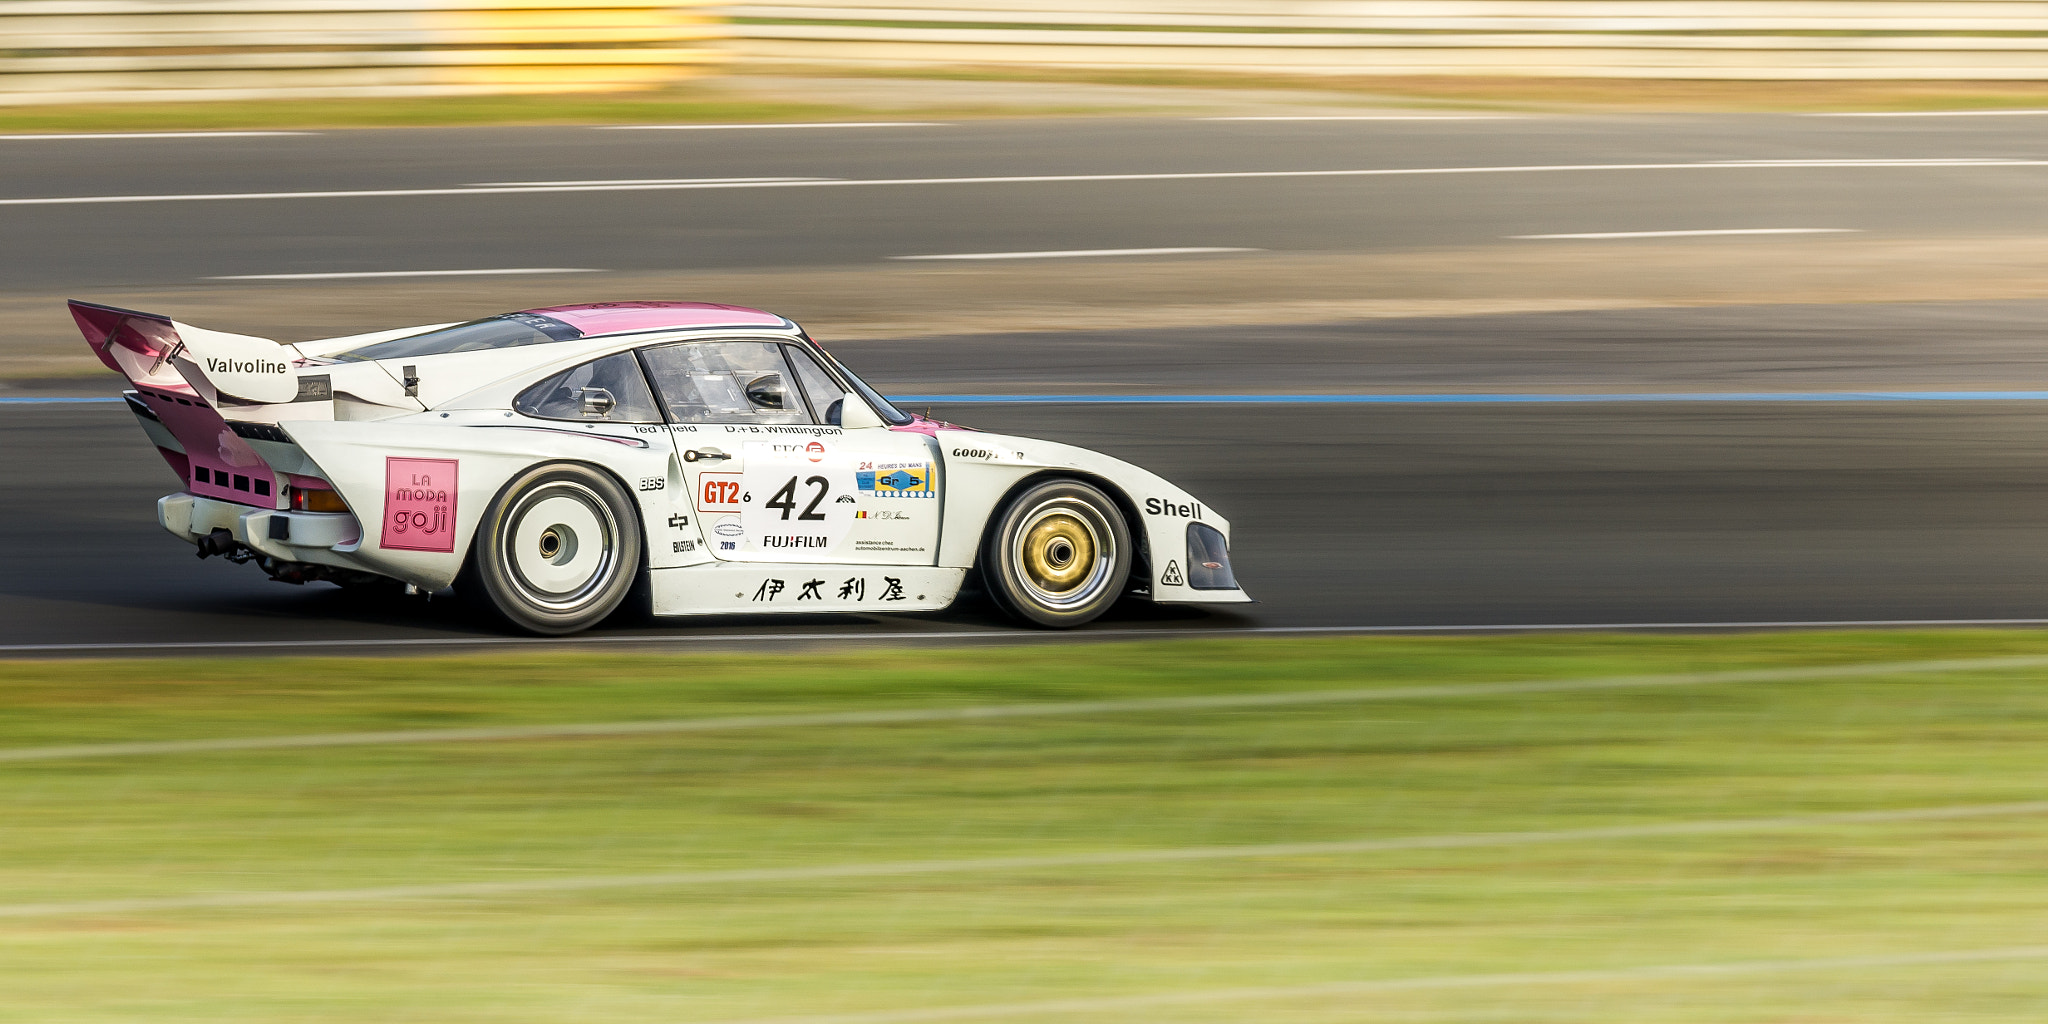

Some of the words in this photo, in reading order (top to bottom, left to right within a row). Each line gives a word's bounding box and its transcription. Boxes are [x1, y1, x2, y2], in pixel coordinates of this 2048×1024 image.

[207, 358, 286, 373] Valvoline
[631, 425, 657, 433] Ted
[660, 425, 697, 433] Field
[764, 426, 842, 437] Whittington
[859, 461, 873, 470] 24
[412, 474, 430, 486] LA
[640, 476, 664, 491] BBS
[881, 476, 899, 485] Gr
[909, 476, 919, 486] 5
[396, 488, 447, 502] MODA
[704, 481, 740, 504] GT2
[743, 491, 752, 503] 6
[765, 475, 829, 520] 42
[1145, 498, 1201, 520] Shell
[393, 505, 447, 535] goji
[673, 540, 695, 553] BILSTEIN
[763, 535, 827, 548] FUJIFILM
